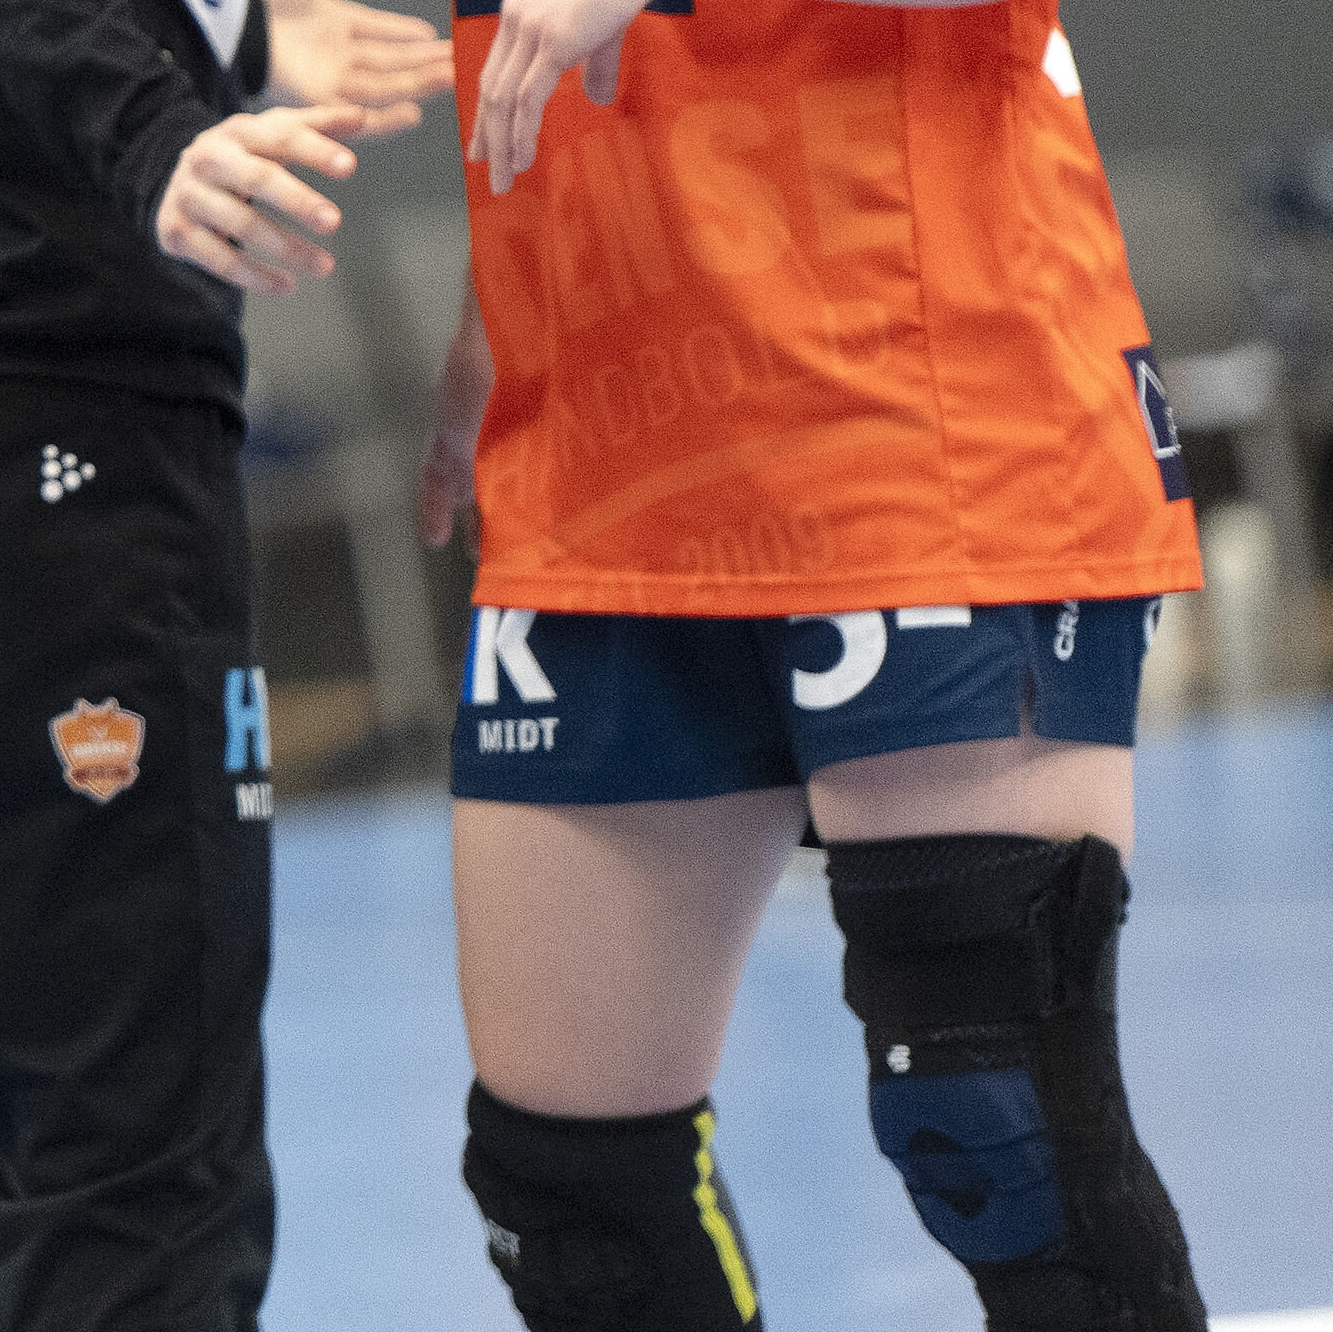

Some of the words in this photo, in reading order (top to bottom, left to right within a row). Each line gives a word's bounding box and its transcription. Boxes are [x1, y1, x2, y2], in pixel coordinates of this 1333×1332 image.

[461, 606, 557, 705] K
[223, 666, 272, 773] H
[479, 718, 560, 753] MIDT
